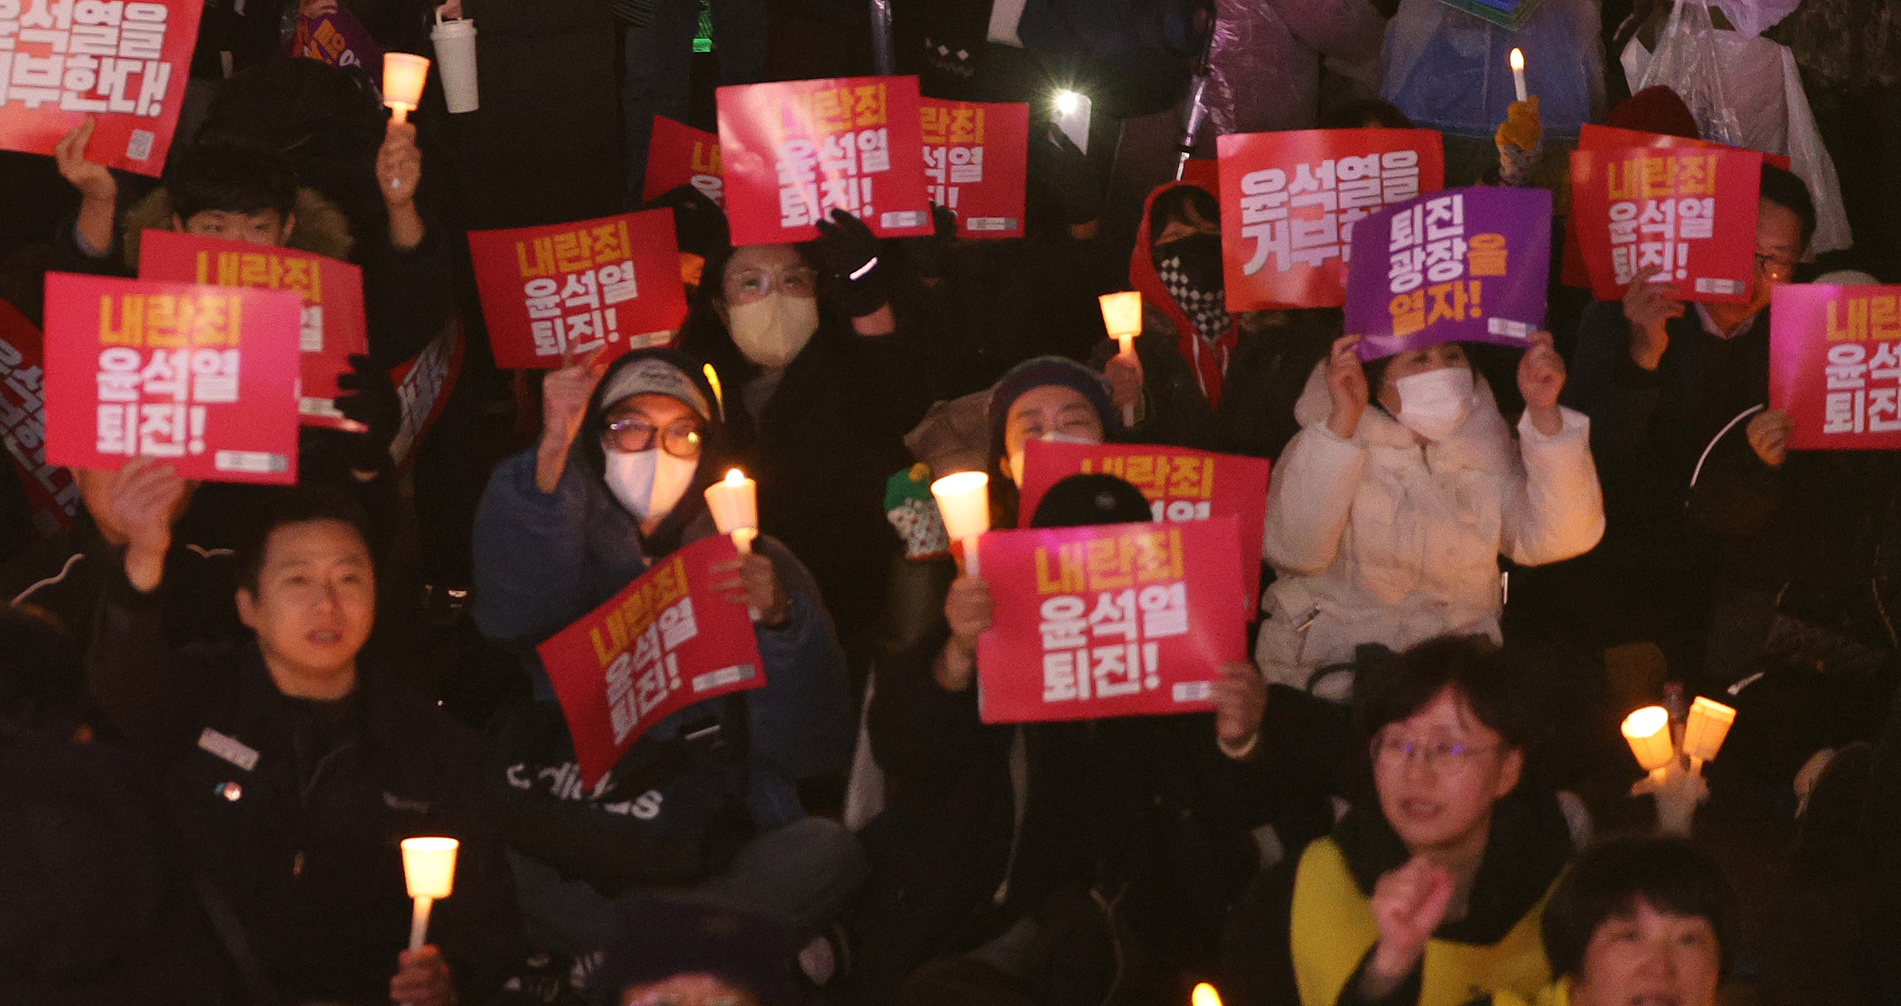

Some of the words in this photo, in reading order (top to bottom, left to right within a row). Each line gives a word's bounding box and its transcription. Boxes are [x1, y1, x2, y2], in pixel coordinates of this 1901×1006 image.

[778, 83, 889, 138] 내란죄
[775, 127, 891, 183] 윤석열
[1604, 159, 1710, 202] 내란죄
[779, 174, 874, 228] 퇴진!
[1239, 148, 1420, 227] 윤석열을
[514, 220, 631, 282] 내란죄
[1387, 194, 1465, 253] 퇴진
[1606, 196, 1715, 249] 윤석열
[195, 250, 322, 307] 내란죄
[1387, 233, 1509, 292] 광장을
[1609, 237, 1690, 286] 퇴진!
[98, 292, 242, 350] 내란죄
[520, 259, 641, 324] 윤석열
[1387, 280, 1483, 335] 열자!
[528, 308, 620, 360] 퇴진!
[94, 344, 241, 406] 윤석열
[94, 399, 209, 460] 퇴진!
[1035, 527, 1185, 600] 내란죄
[588, 556, 691, 669] 내란죄
[1038, 582, 1190, 655] 윤석열
[604, 595, 698, 703] 윤석열
[1042, 641, 1160, 708] 퇴진!
[609, 649, 685, 747] 퇴진!
